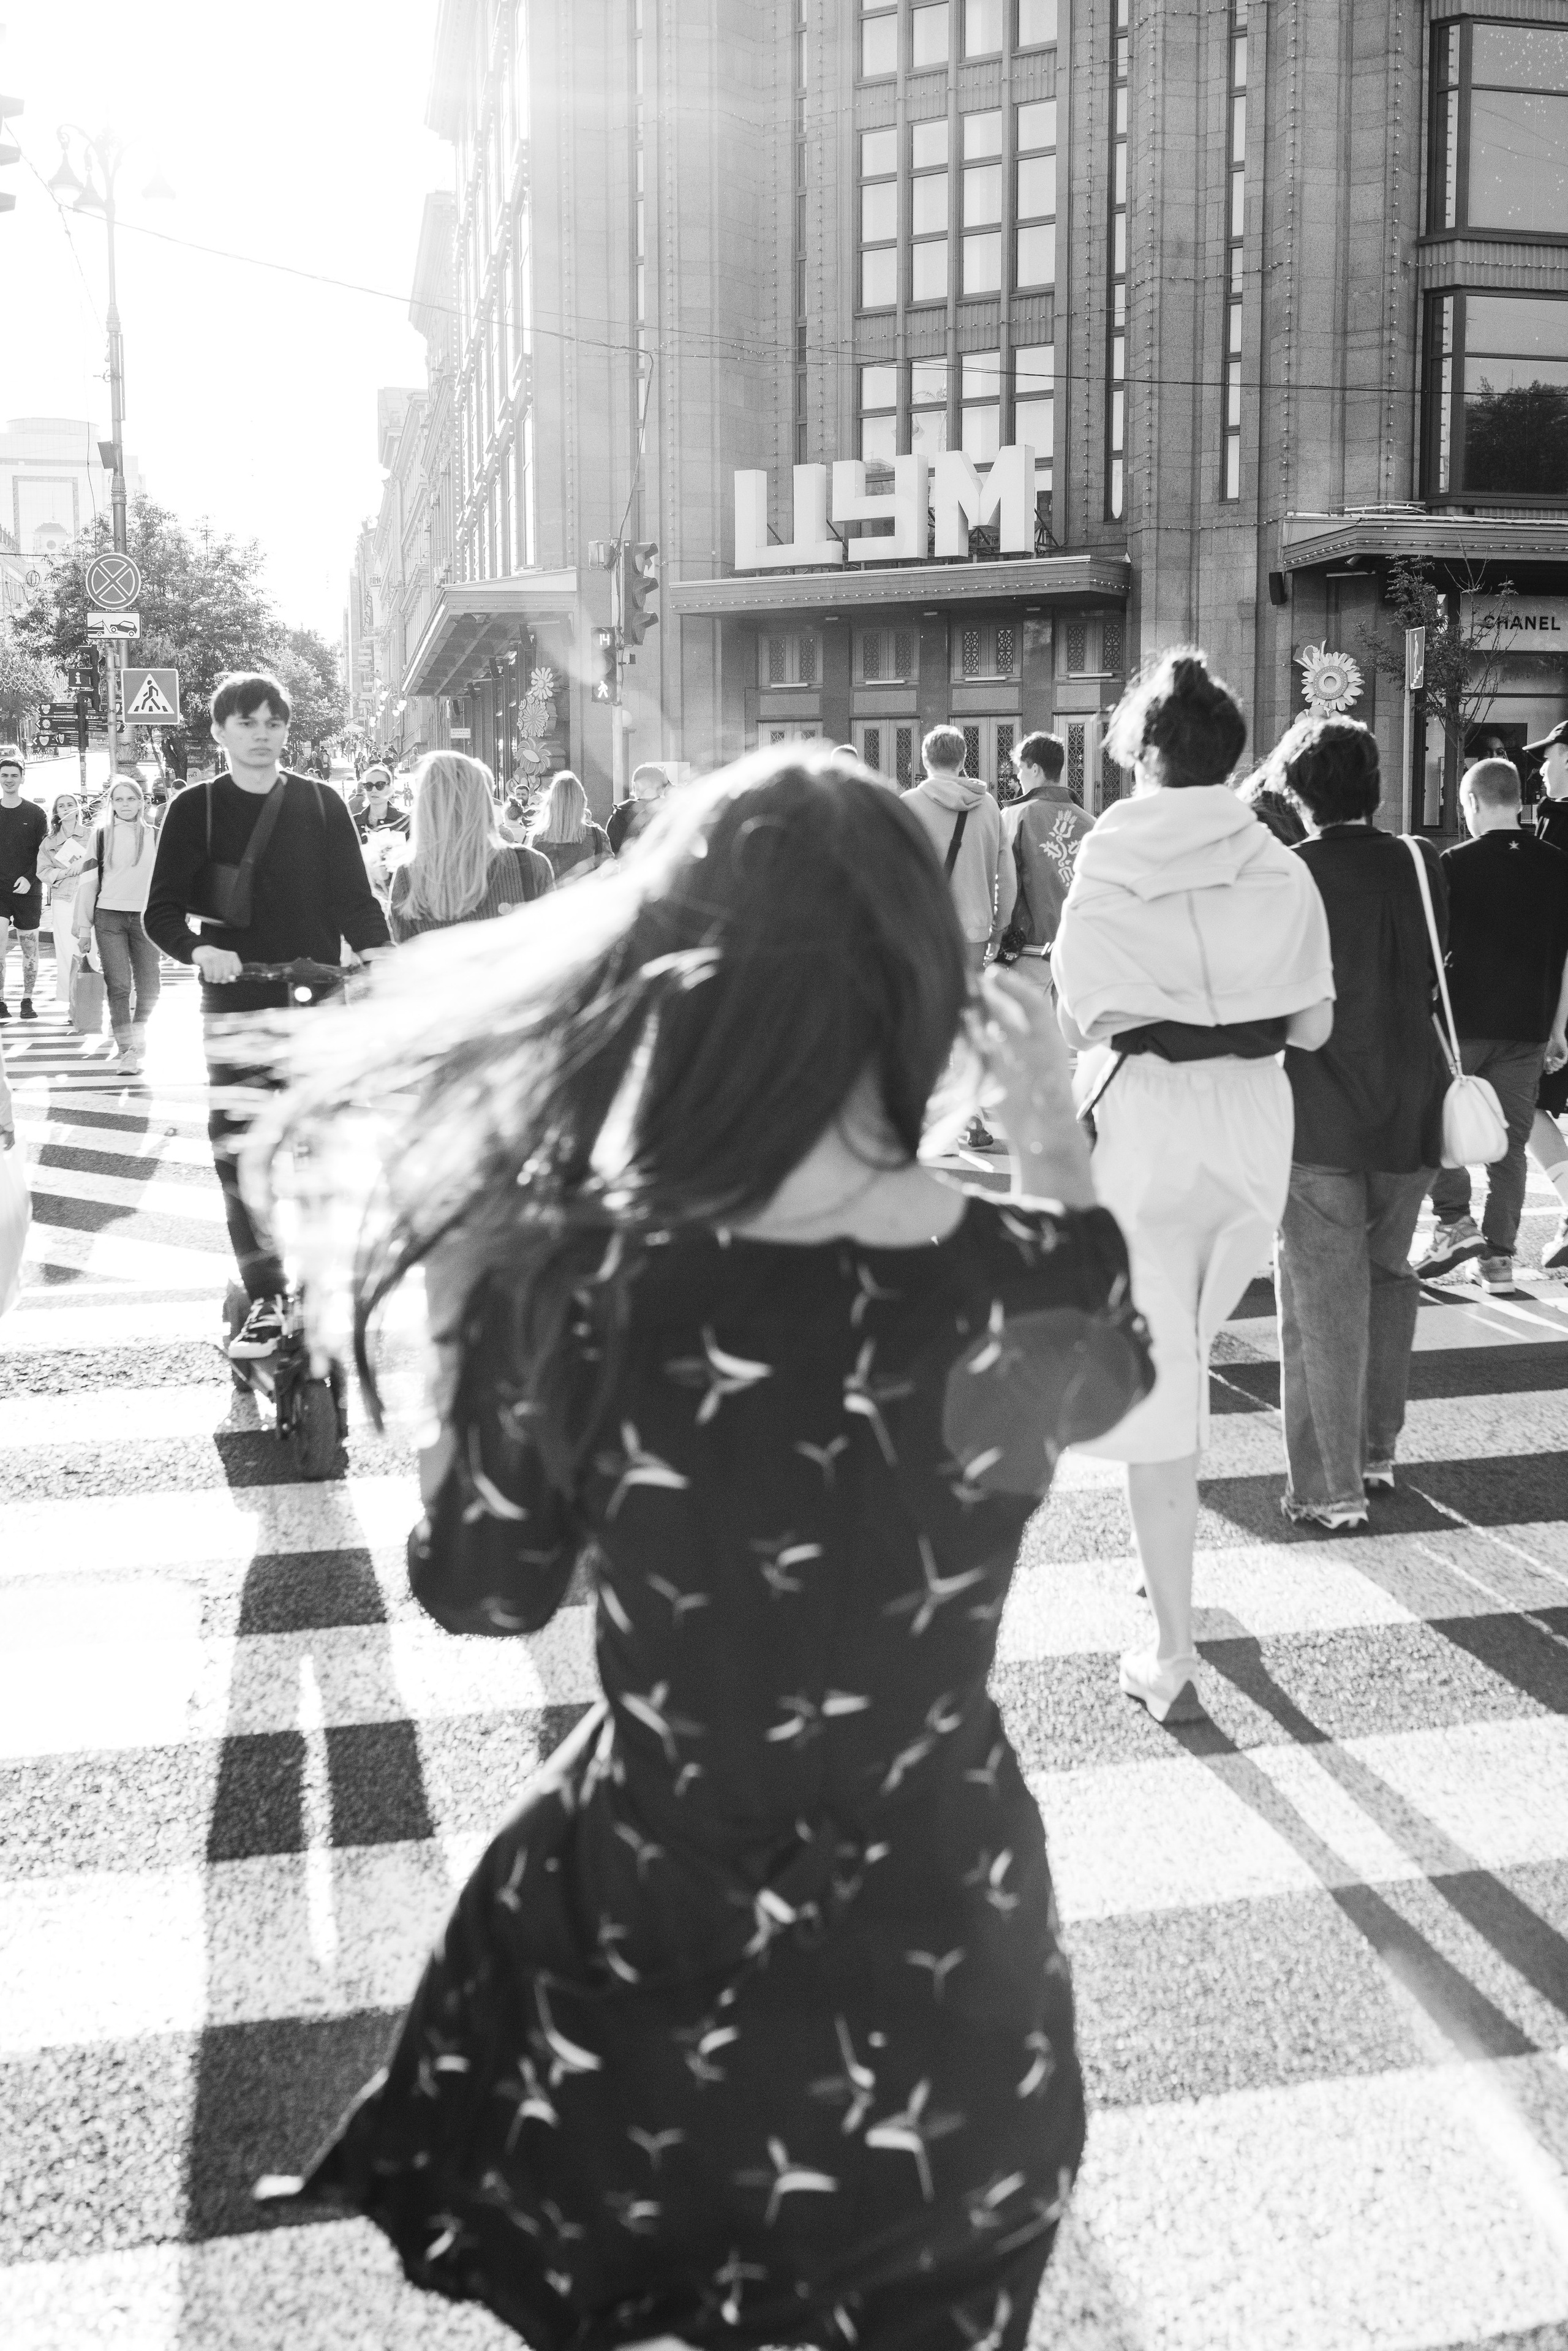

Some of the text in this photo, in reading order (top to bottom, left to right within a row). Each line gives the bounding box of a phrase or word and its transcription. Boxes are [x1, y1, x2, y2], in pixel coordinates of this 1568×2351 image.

[734, 445, 1035, 570] ЦУМ
[1484, 616, 1561, 630] CHANEL
[600, 633, 610, 646] 14
